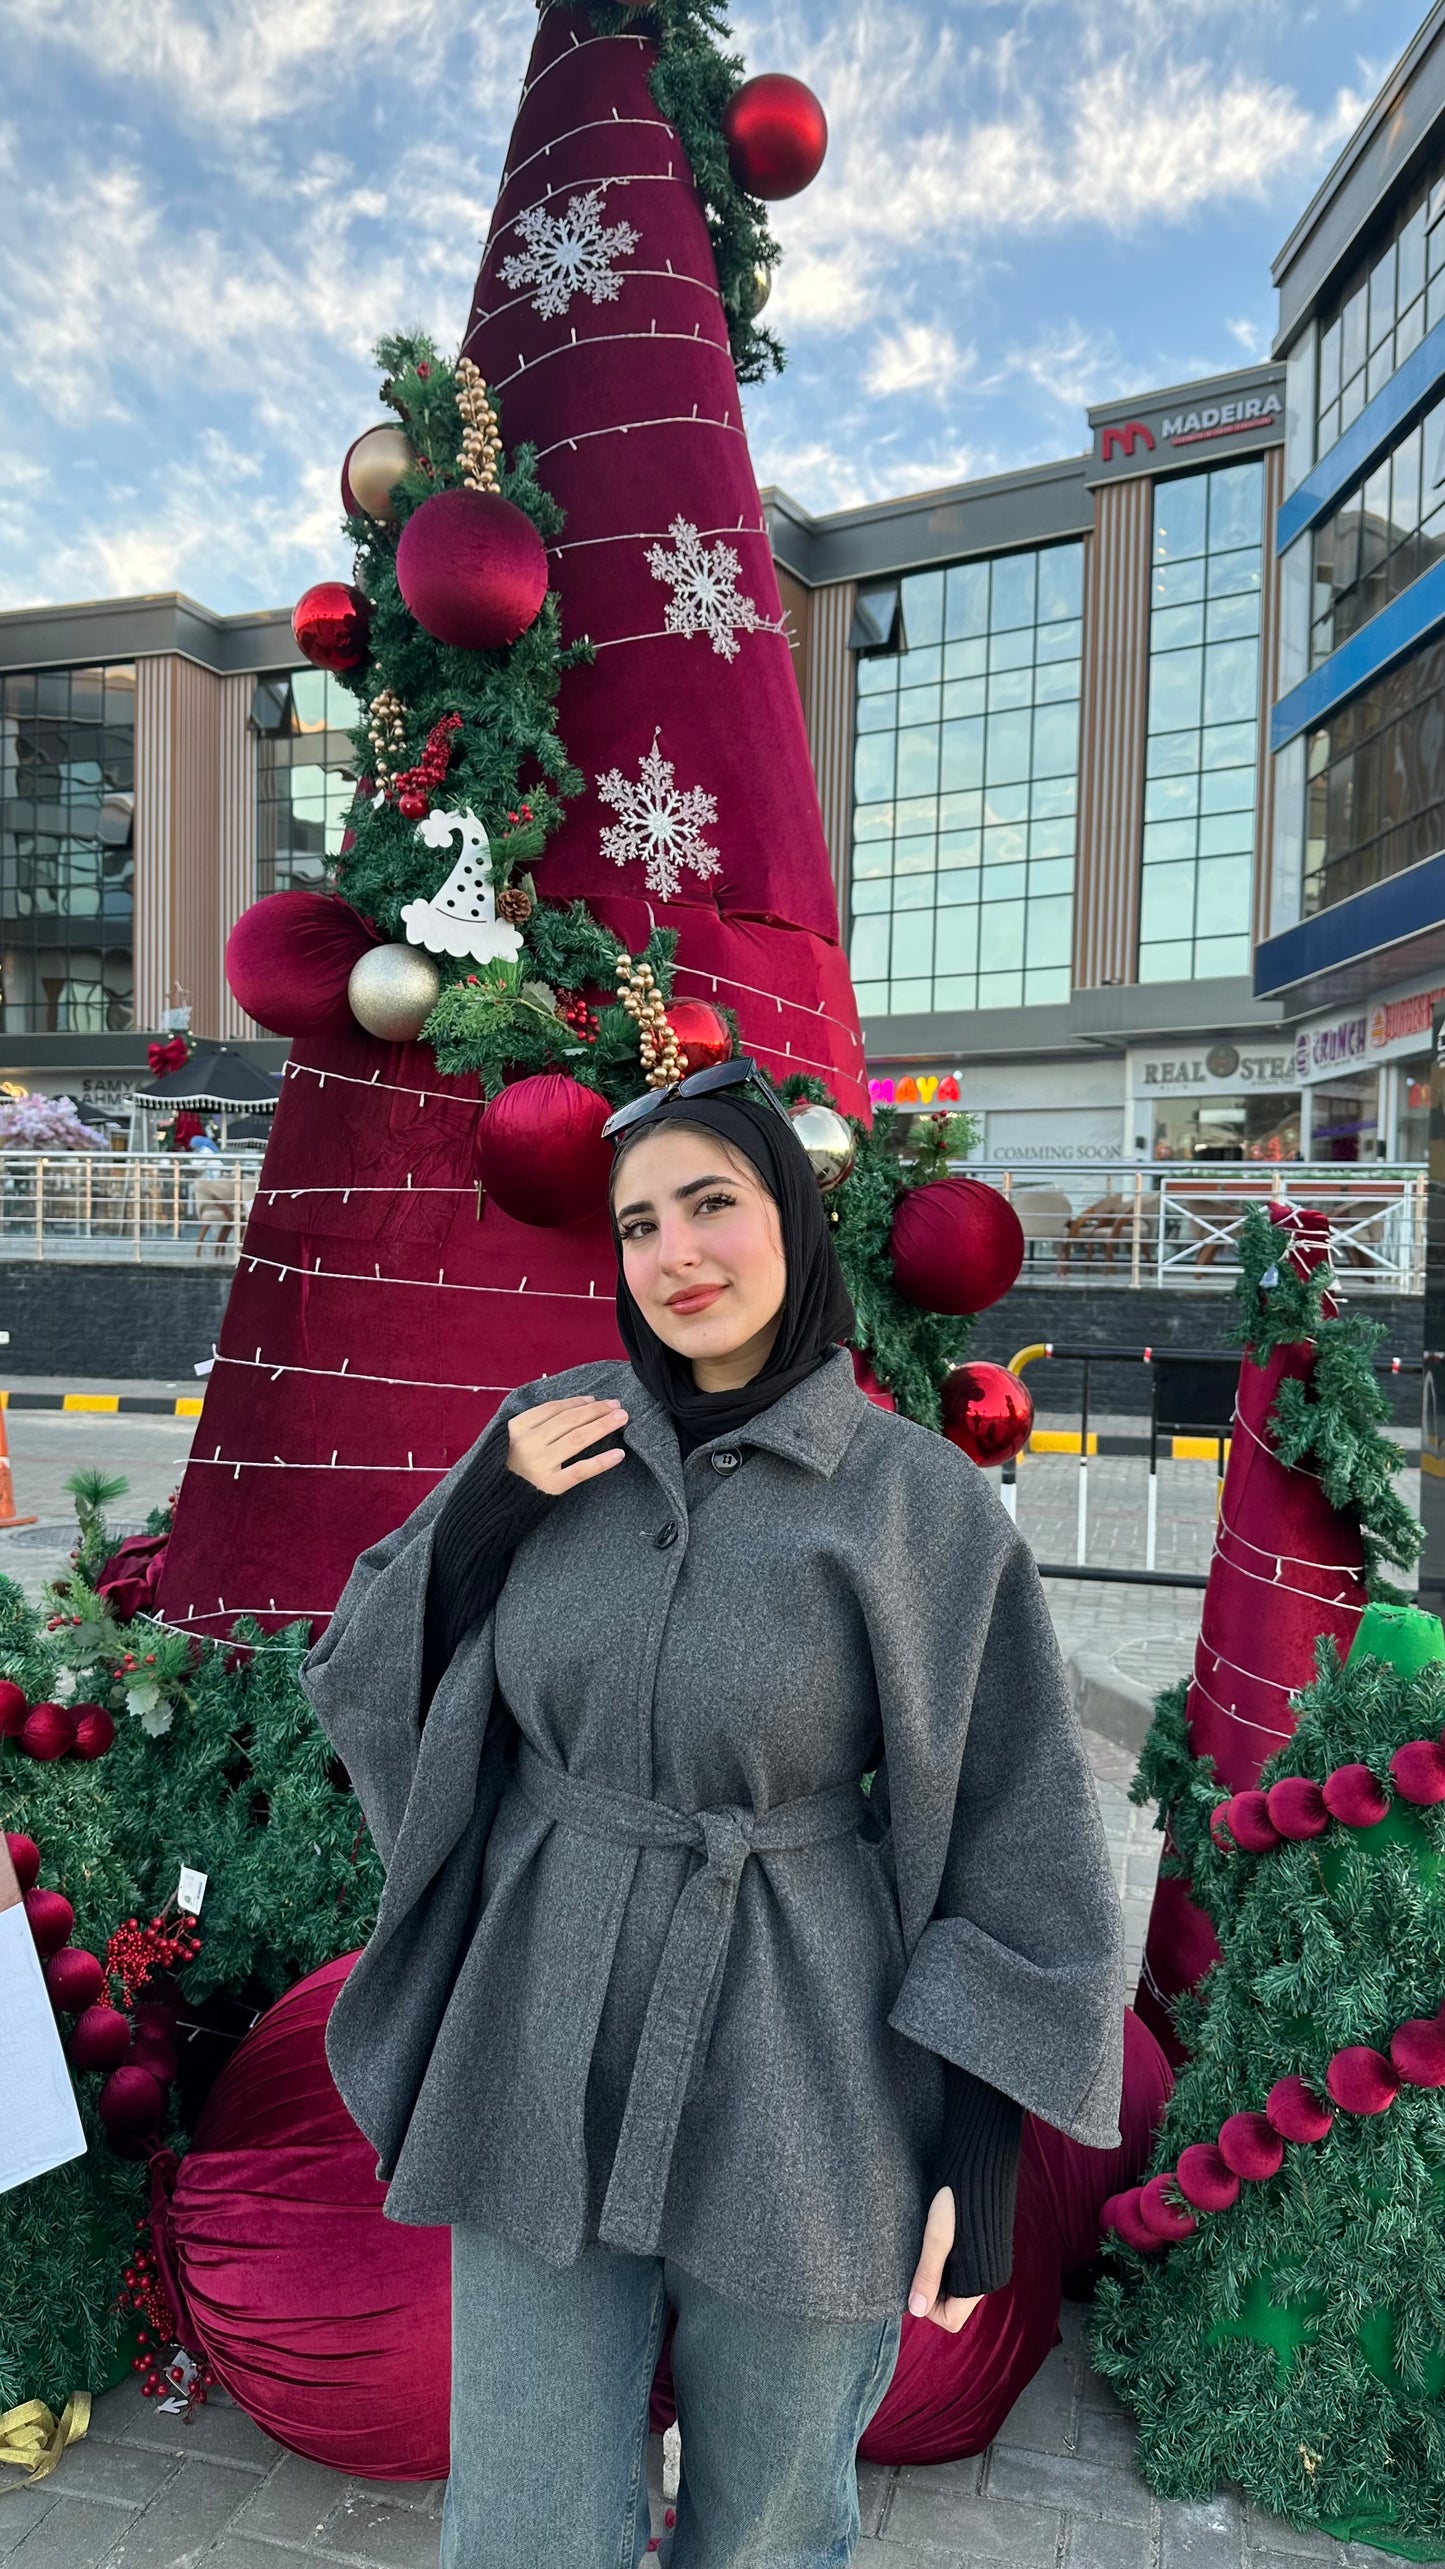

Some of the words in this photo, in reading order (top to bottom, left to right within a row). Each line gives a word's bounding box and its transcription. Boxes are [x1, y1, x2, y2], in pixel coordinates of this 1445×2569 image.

[1161, 393, 1283, 438] MADEIRA
[1312, 1017, 1367, 1065] CRUNCH
[1144, 1060, 1206, 1084] REAL
[993, 1145, 1074, 1160] COMMING
[1076, 1144, 1121, 1160] SOON
